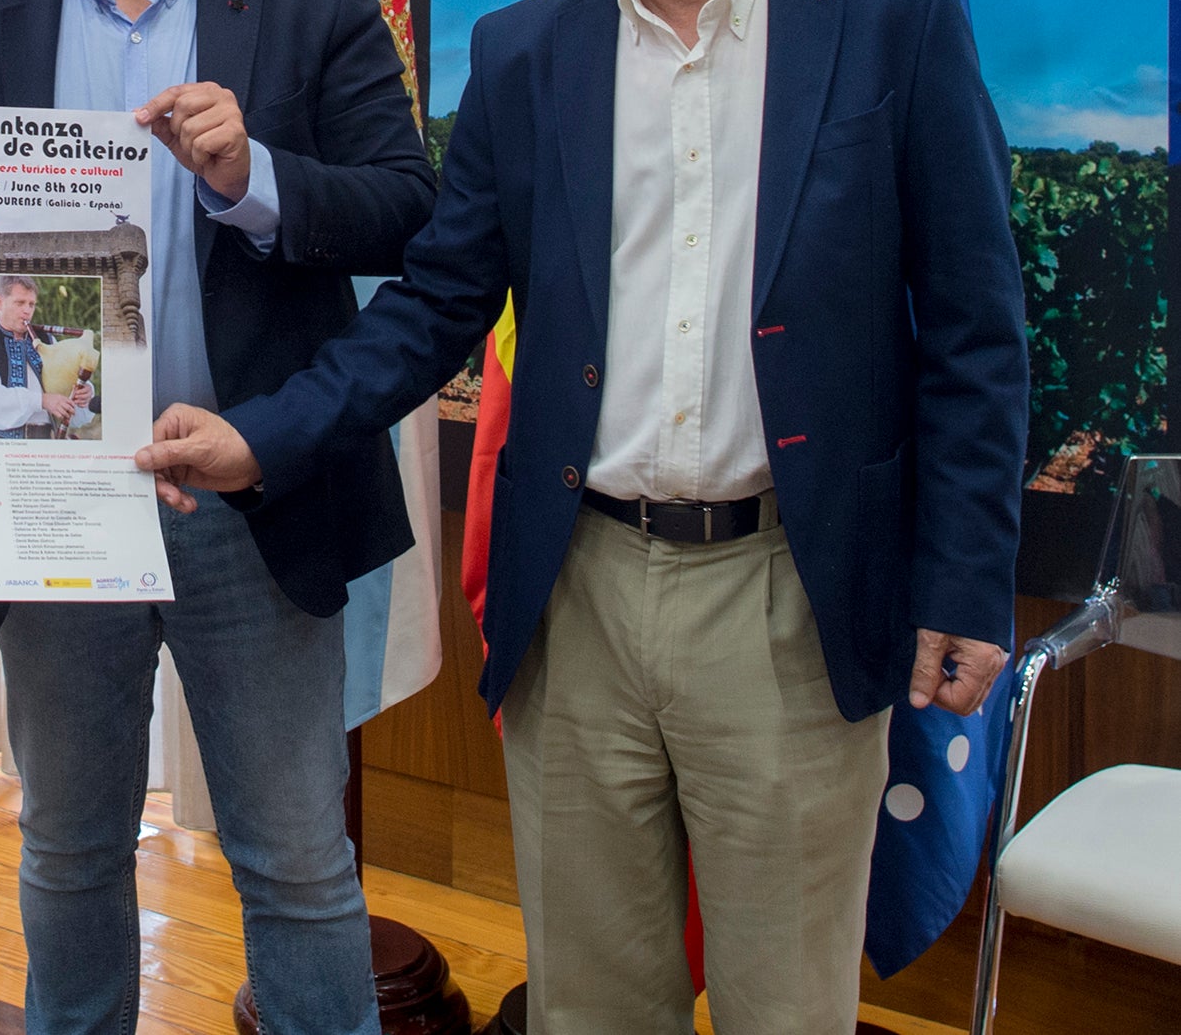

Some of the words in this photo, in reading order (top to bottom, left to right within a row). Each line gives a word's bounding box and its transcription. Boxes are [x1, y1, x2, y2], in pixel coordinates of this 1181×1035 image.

[3, 137, 34, 157] de
[42, 138, 148, 161] Gaiteiros
[70, 167, 77, 175] e
[80, 167, 123, 177] cultural
[11, 181, 40, 192] June
[45, 182, 66, 193] 8th
[70, 183, 102, 194] 2019
[45, 198, 81, 208] (Galicia
[89, 200, 123, 211] España)
